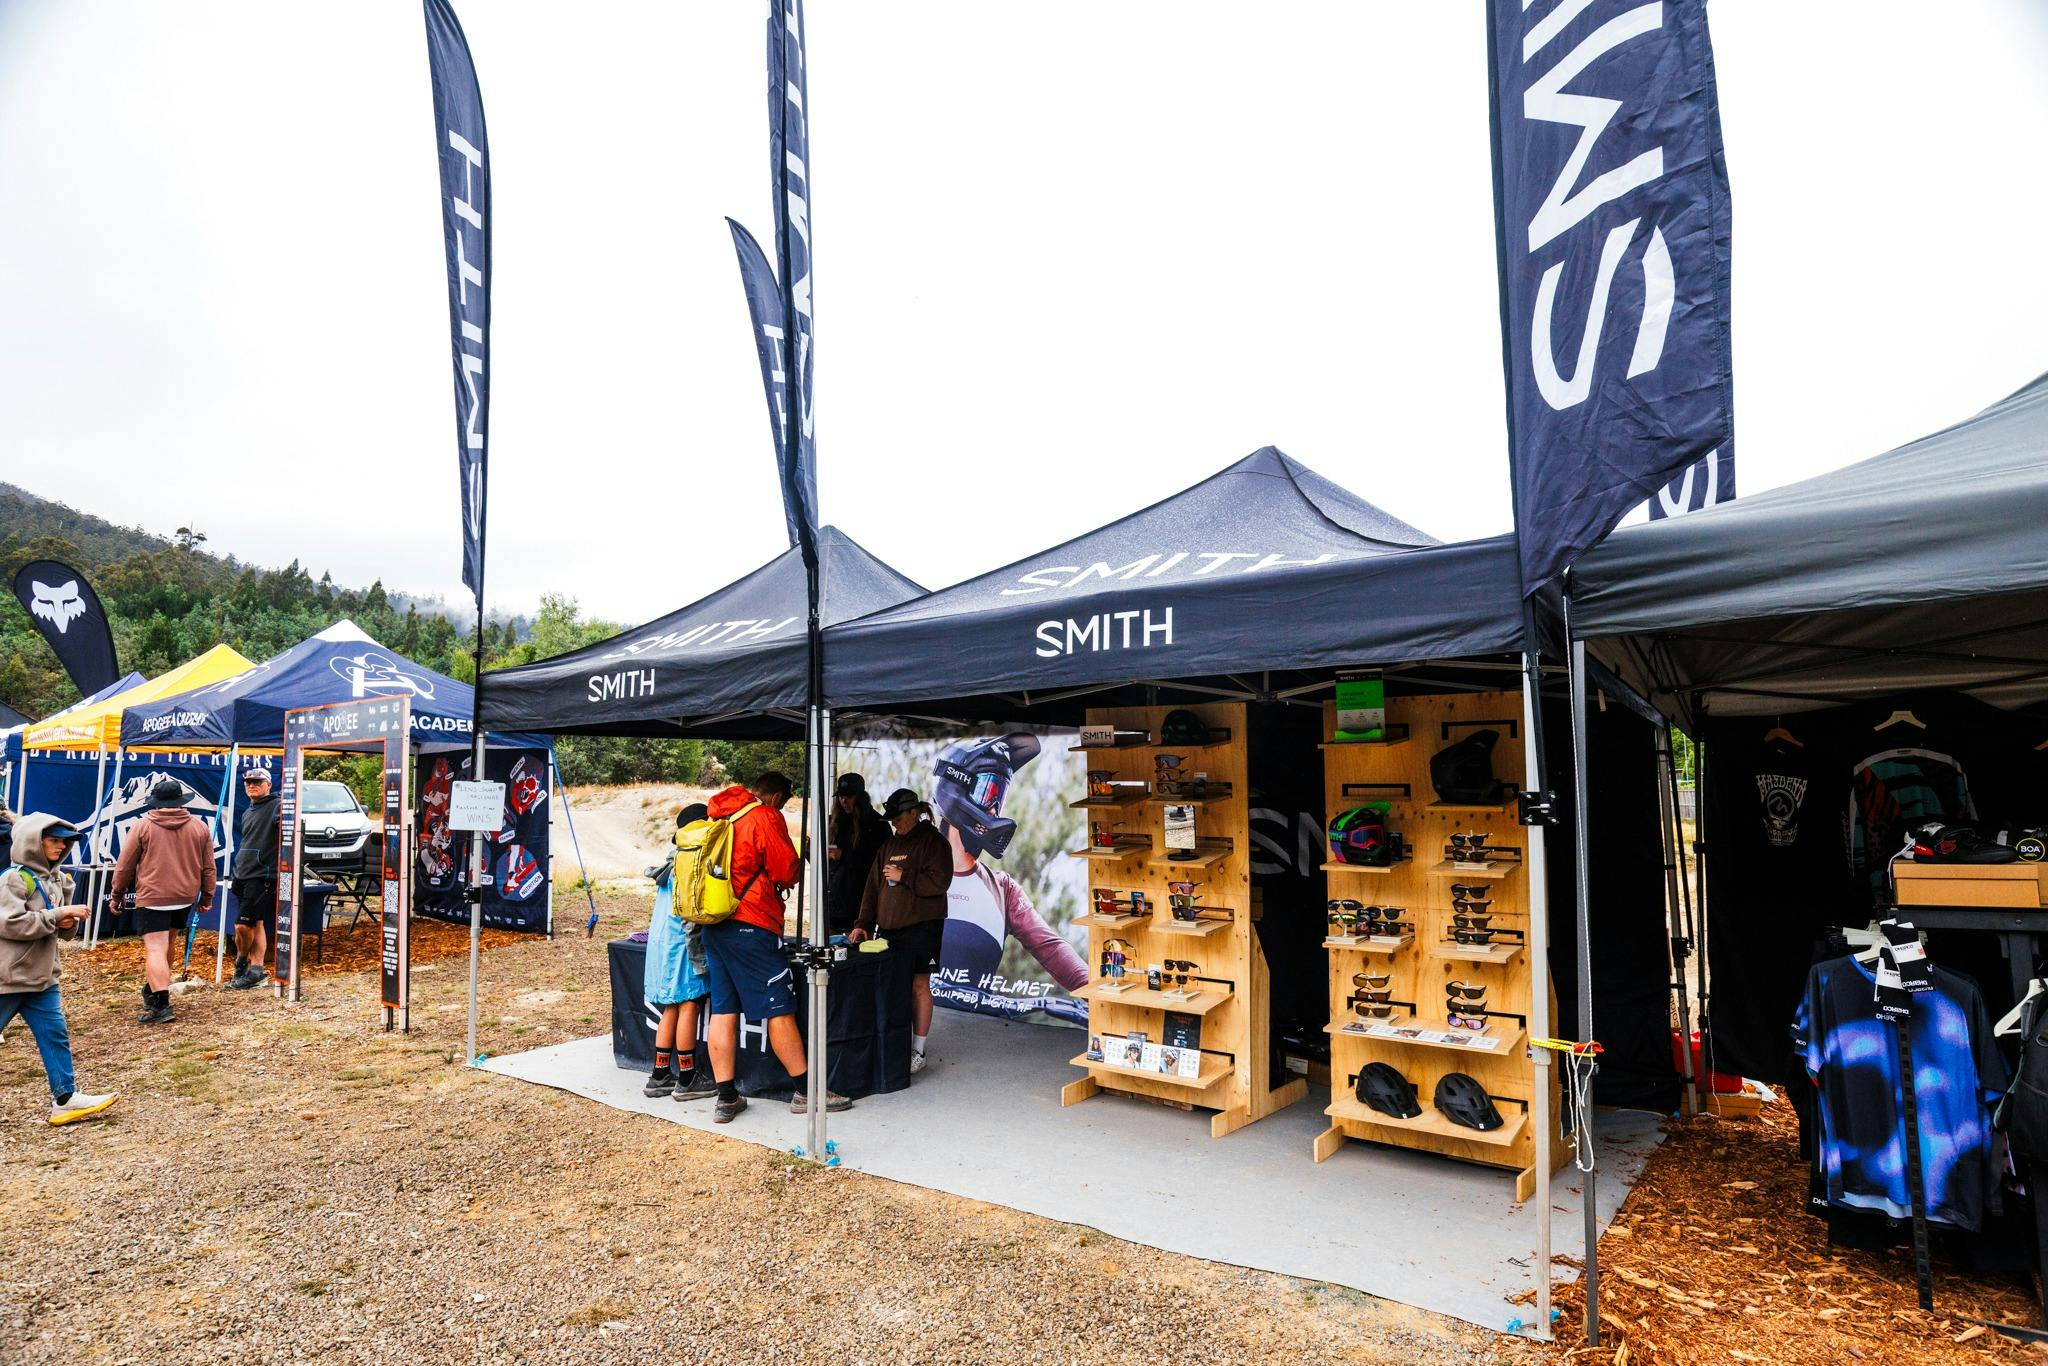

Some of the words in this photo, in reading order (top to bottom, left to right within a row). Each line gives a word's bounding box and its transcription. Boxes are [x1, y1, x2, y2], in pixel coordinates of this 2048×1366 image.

[999, 552, 1339, 597] SMITH
[1035, 606, 1173, 658] SMITH
[587, 668, 656, 703] SMITH
[1082, 731, 1111, 741] SMITH
[946, 766, 972, 785] SMITH
[2020, 845, 2041, 853] BOA
[521, 873, 543, 896] NUTRITION
[978, 973, 1055, 997] HELMET
